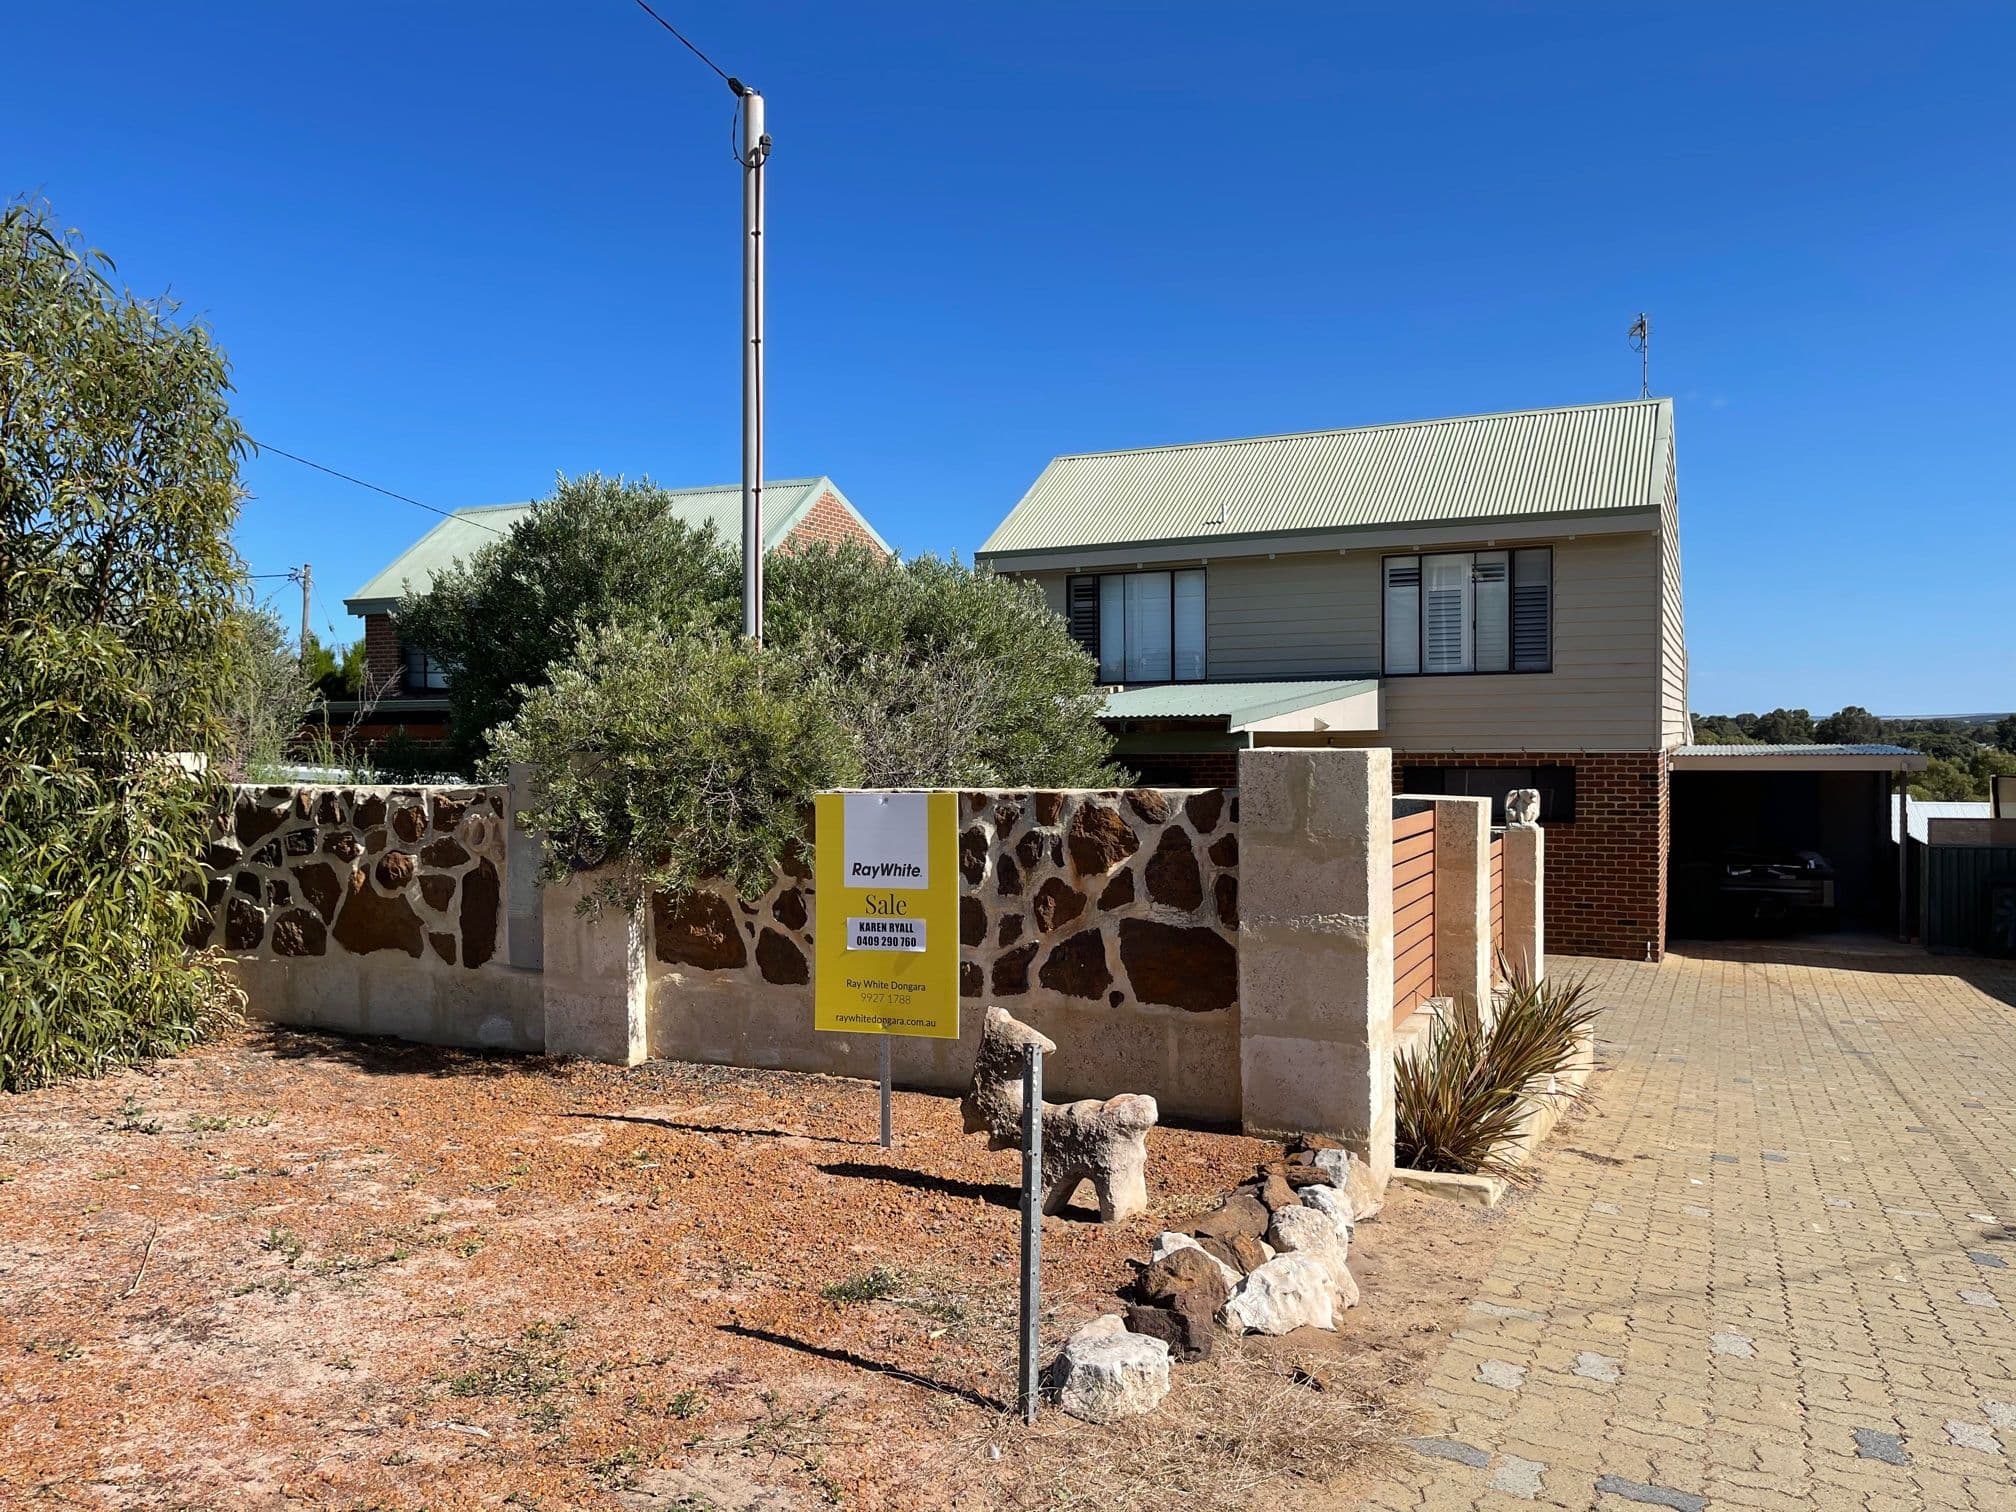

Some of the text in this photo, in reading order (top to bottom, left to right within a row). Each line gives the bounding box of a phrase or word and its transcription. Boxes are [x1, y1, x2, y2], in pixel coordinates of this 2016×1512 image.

[865, 893, 907, 915] Sale
[859, 922, 914, 933] KAREN RYALL
[856, 936, 917, 947] 0409 290 760
[846, 979, 926, 992] Ray White Dongara
[861, 992, 911, 1004] 9927 1788
[835, 1014, 936, 1028] raywhitedongara.com.au
